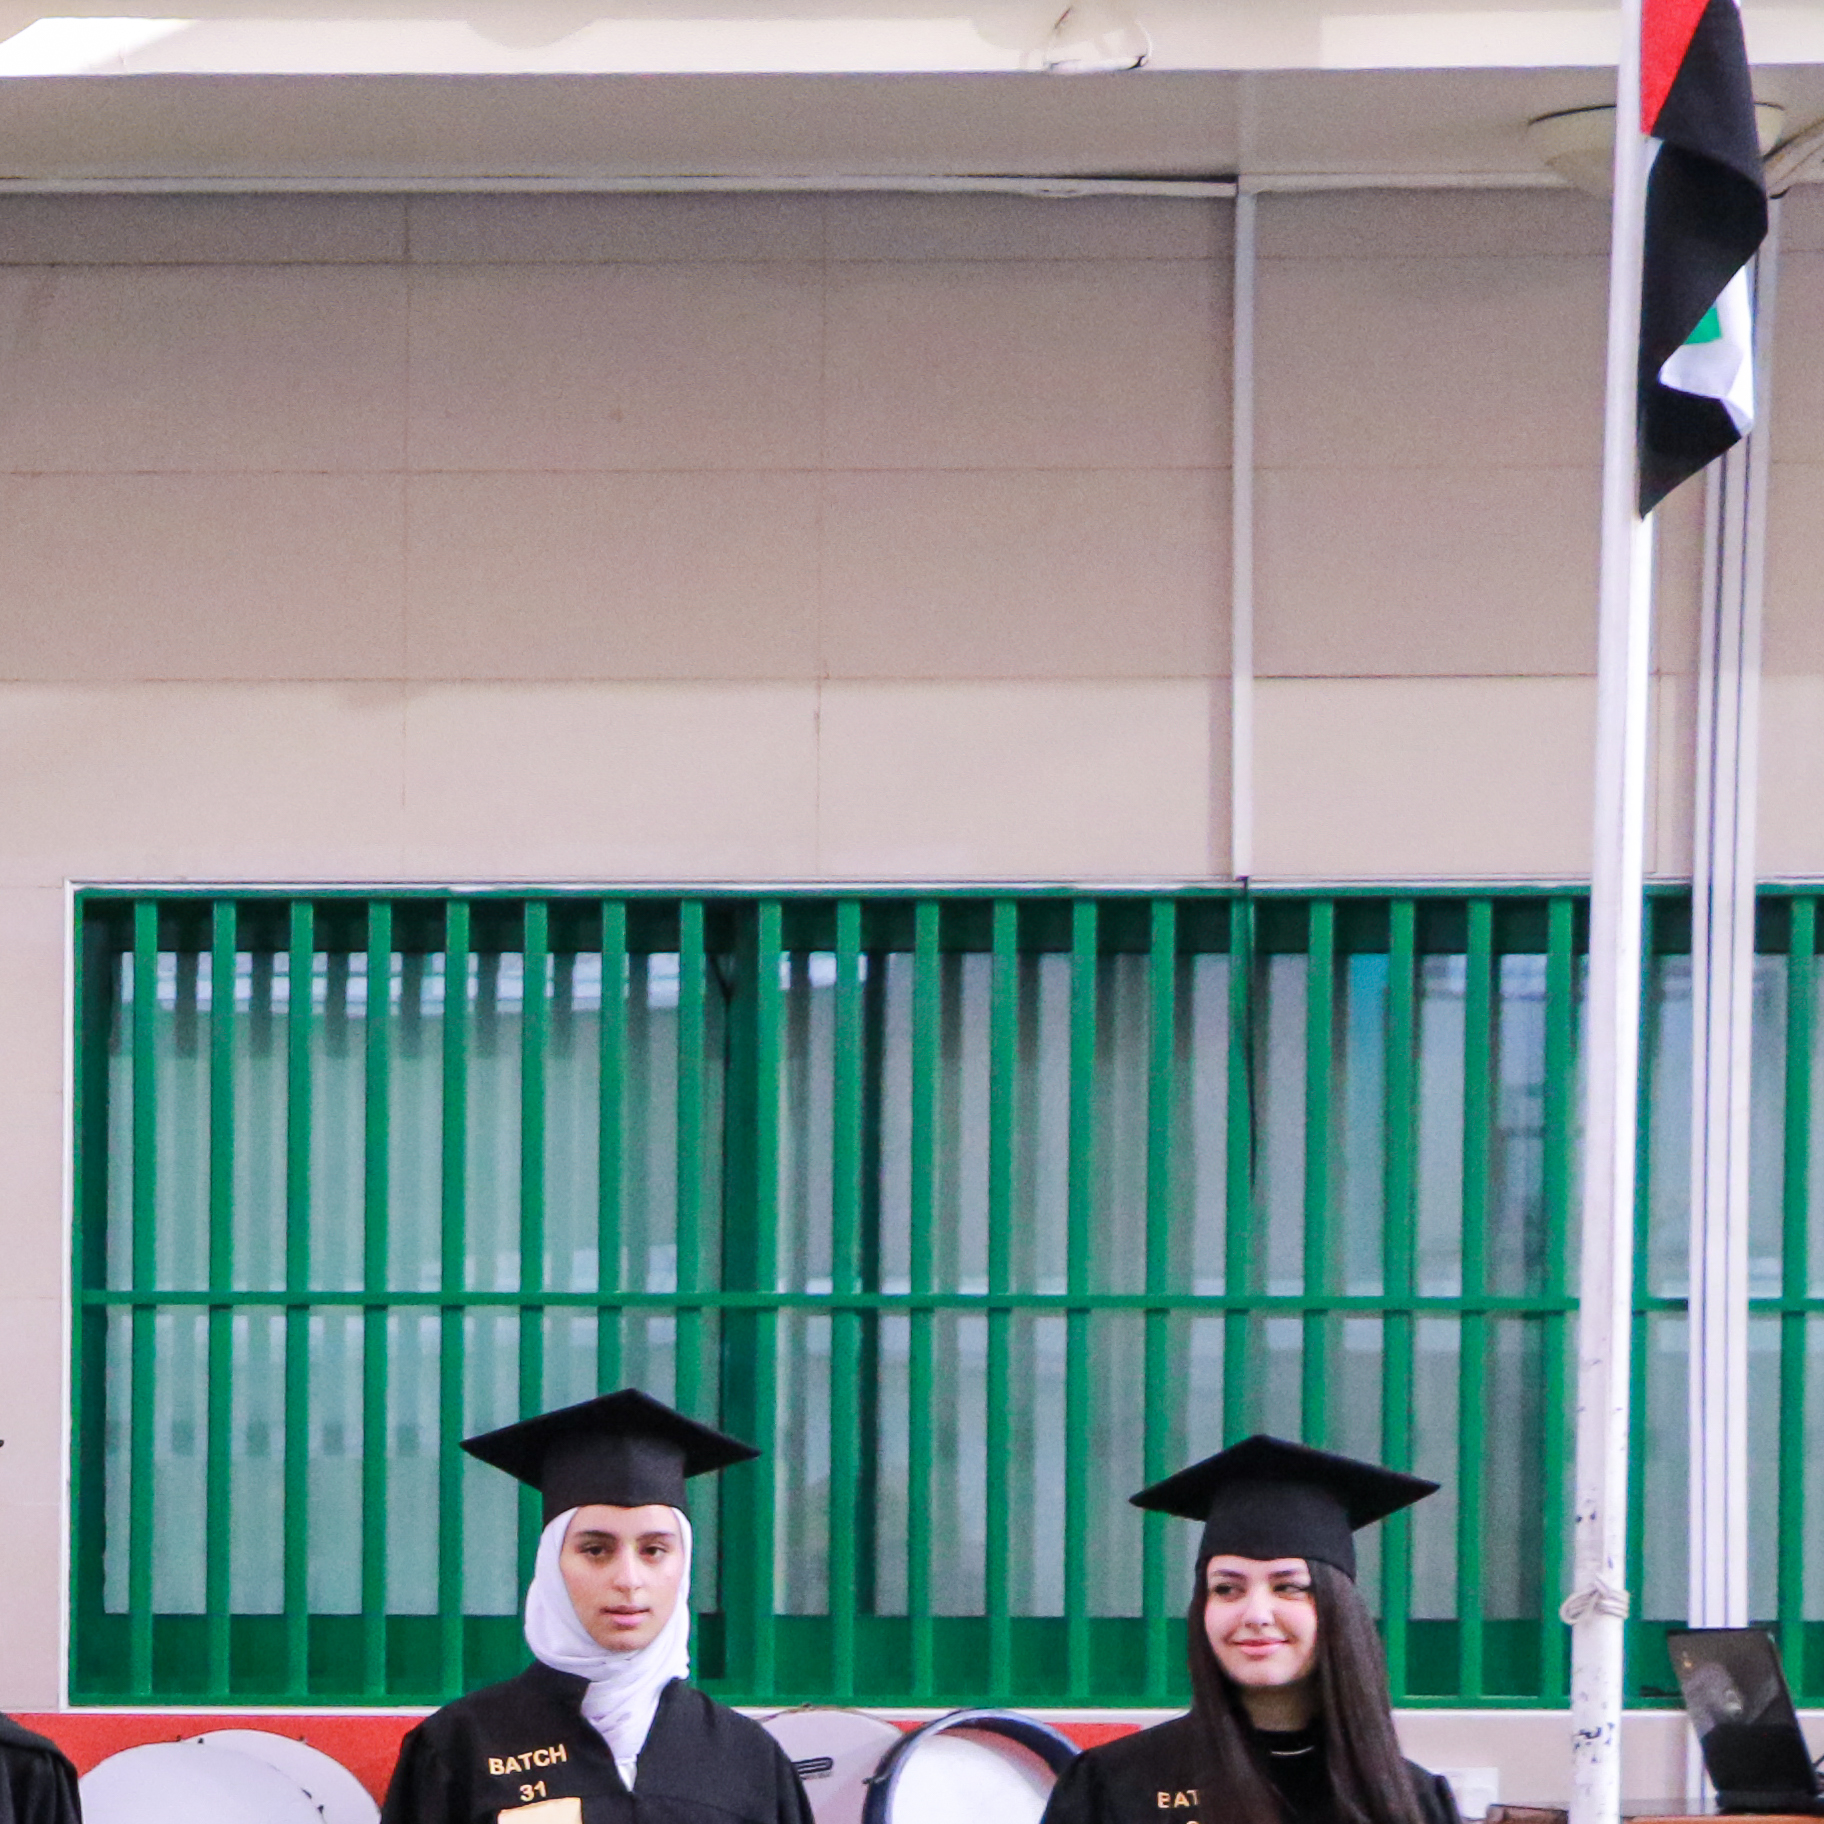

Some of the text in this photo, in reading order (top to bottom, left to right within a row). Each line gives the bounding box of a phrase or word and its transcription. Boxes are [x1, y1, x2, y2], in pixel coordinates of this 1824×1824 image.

[488, 1743, 568, 1776] BATCH
[519, 1780, 548, 1802] 31
[1157, 1789, 1200, 1809] BAT
